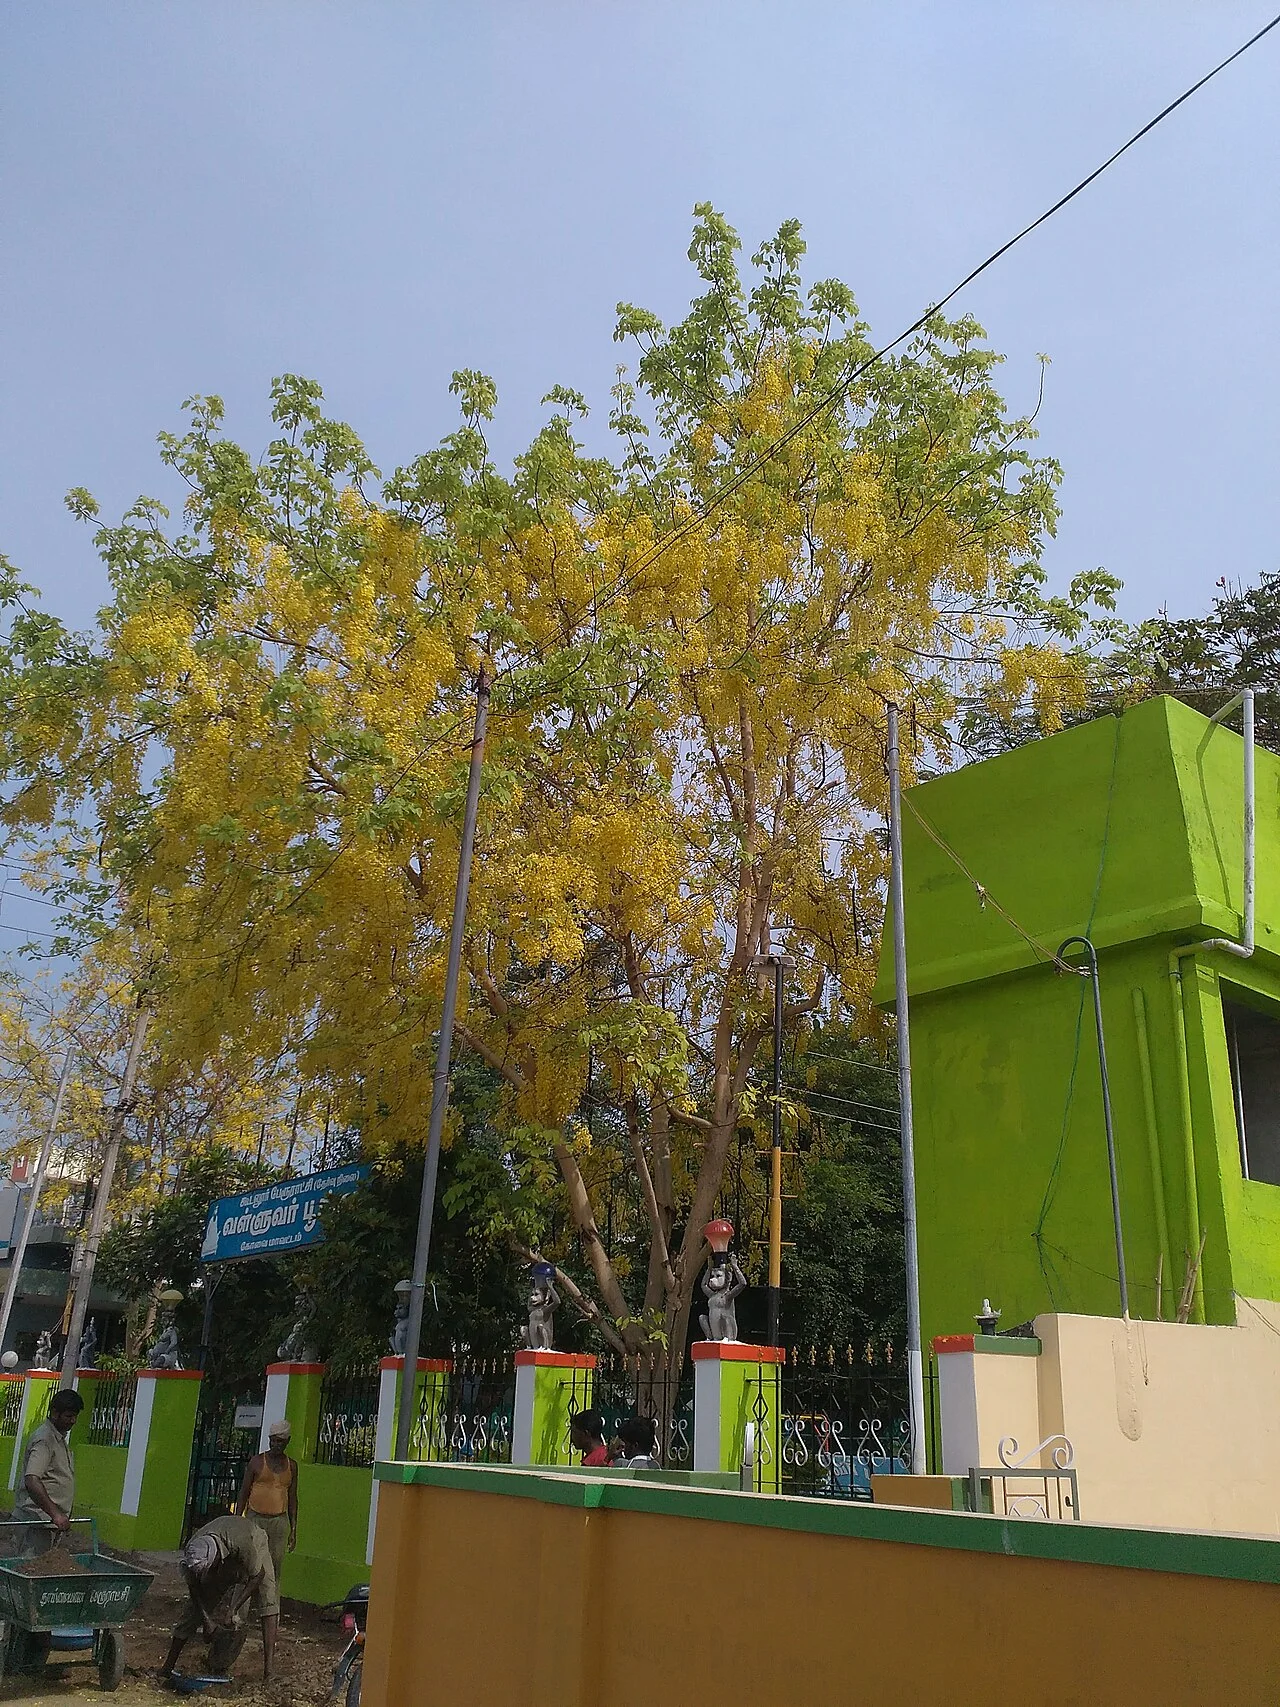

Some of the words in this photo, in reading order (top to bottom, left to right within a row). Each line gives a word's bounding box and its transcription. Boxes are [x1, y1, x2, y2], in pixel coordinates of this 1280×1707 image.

[271, 1177, 314, 1200] பேரூராட்சி
[223, 1197, 299, 1236] வள்ளுவர்
[240, 1241, 268, 1251] கோவை
[268, 1231, 302, 1247] மாவட்டம்
